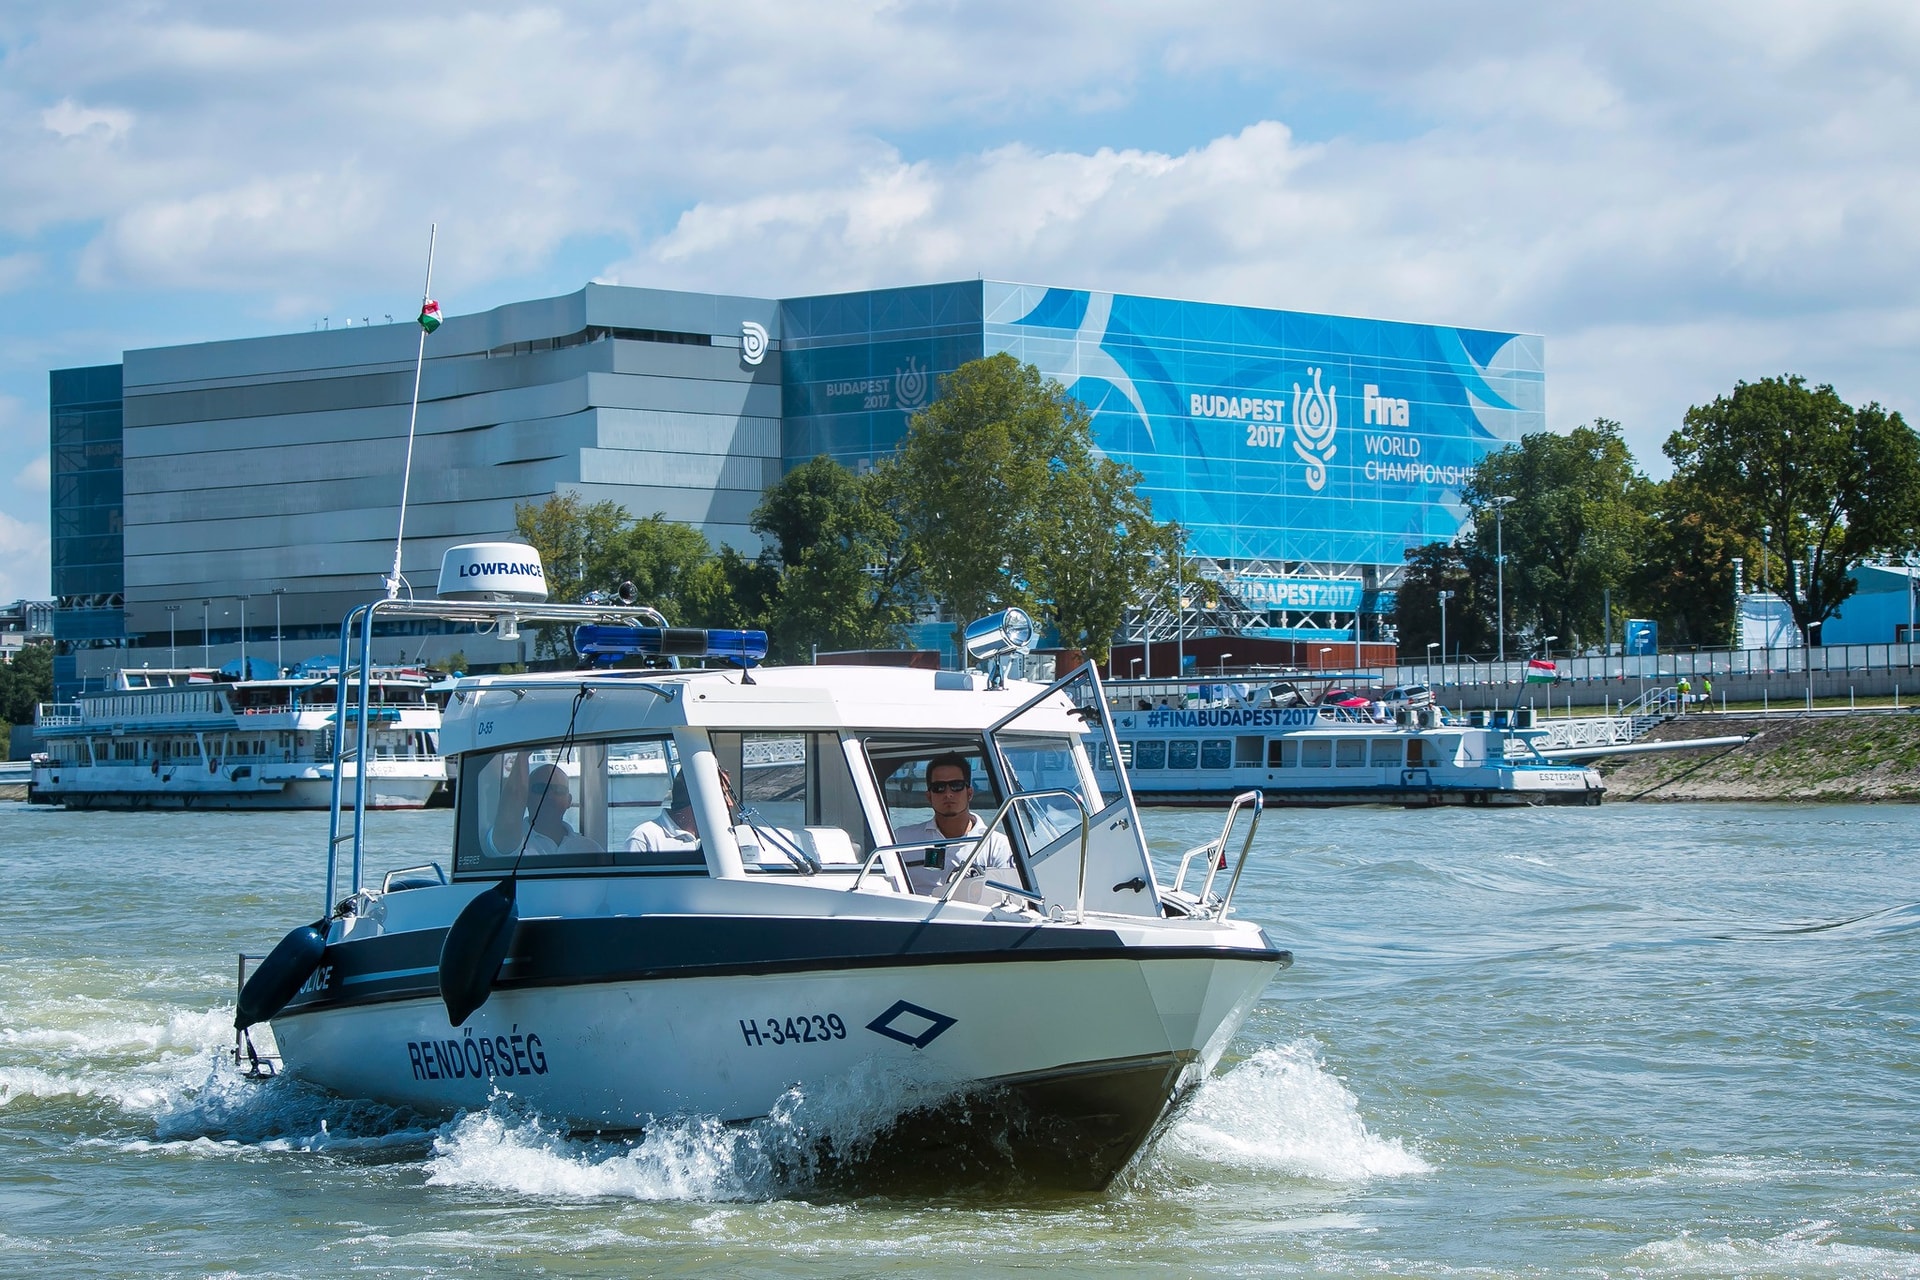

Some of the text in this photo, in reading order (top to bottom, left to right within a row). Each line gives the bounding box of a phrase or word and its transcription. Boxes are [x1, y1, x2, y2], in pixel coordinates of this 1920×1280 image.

[826, 379, 890, 396] BUDAPEST
[864, 394, 889, 409] 2017
[1190, 393, 1285, 422] BUDAPEST
[1246, 424, 1285, 448] 2017
[1364, 434, 1420, 457] WORLD
[459, 562, 542, 577] LOWRANCE
[1147, 708, 1318, 728] #FINABUDAPEST2017
[739, 1013, 847, 1046] H-34239
[407, 1023, 549, 1081] RENDŐRSÉG
